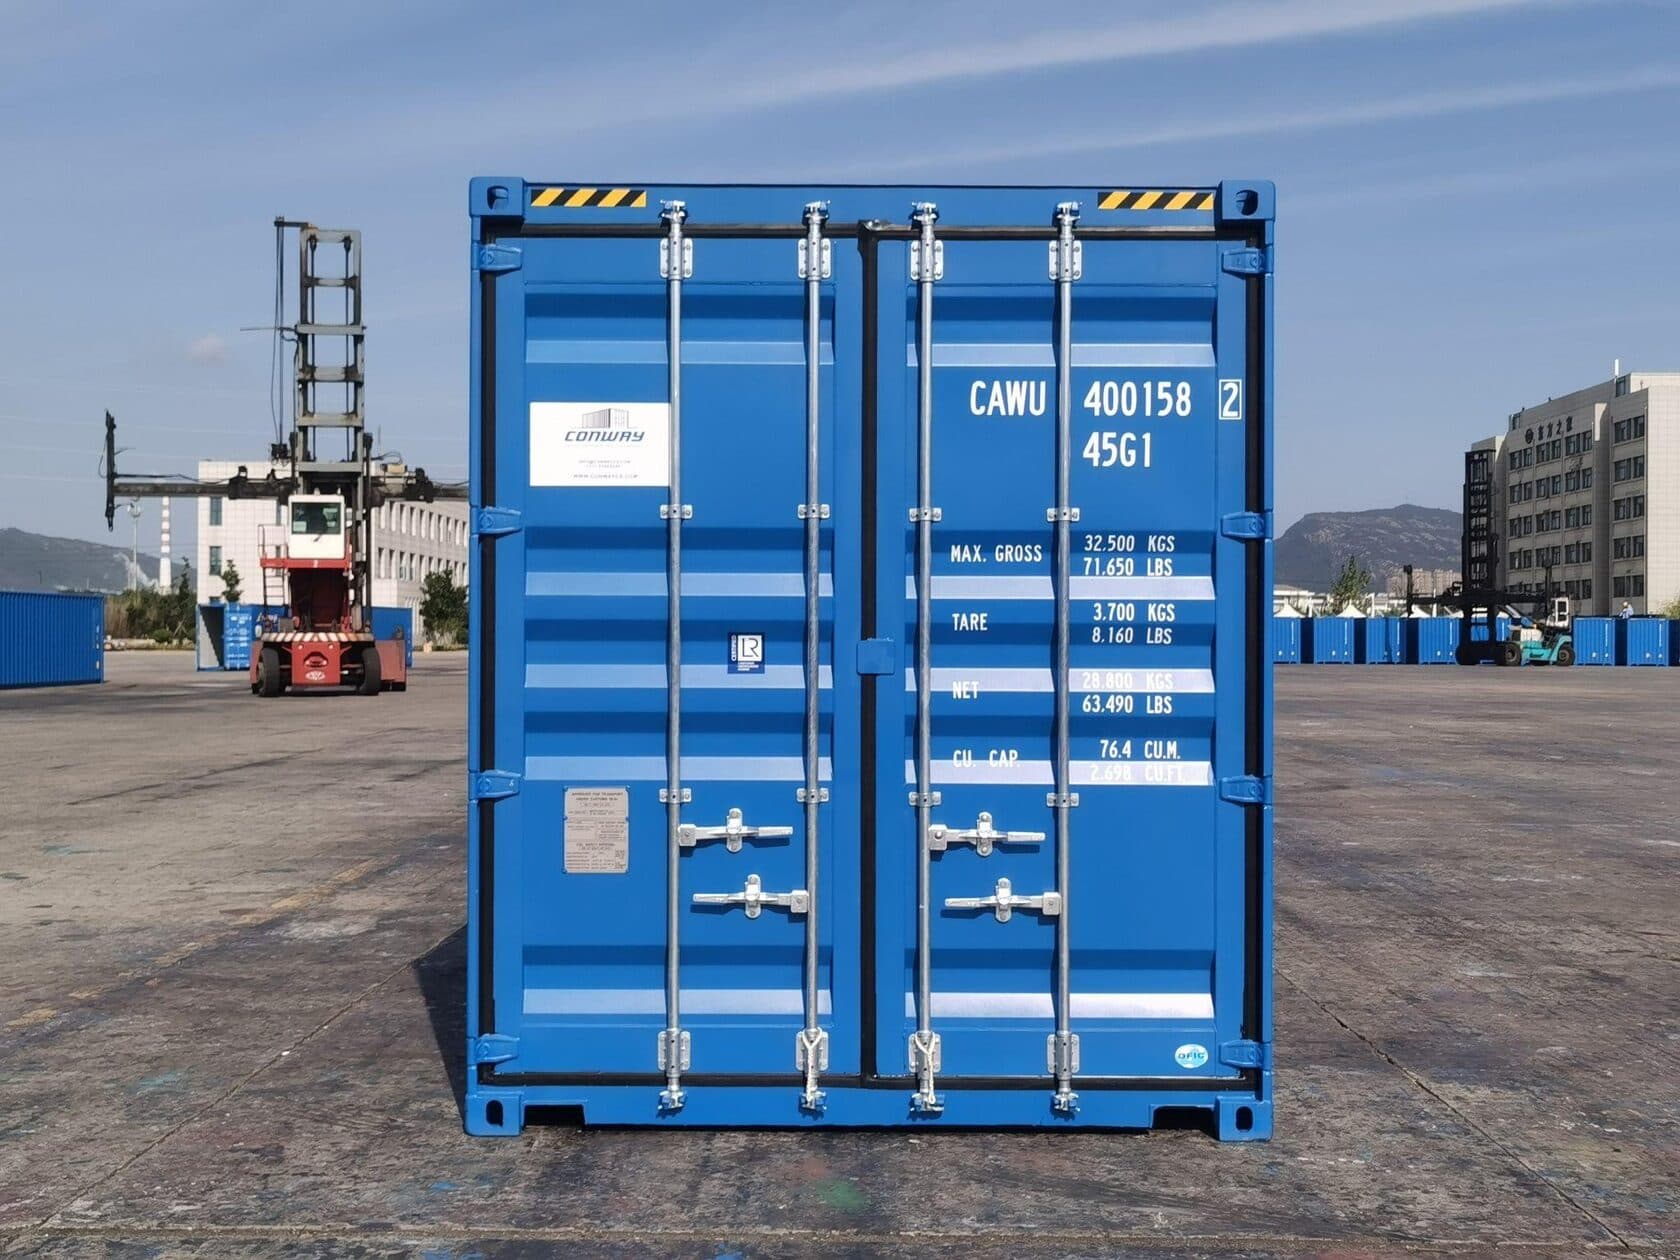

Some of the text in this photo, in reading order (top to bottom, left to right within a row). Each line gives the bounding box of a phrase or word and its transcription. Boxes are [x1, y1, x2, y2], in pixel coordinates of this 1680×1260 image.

[970, 380, 1239, 417] CAWU 400158 2
[564, 431, 645, 442] CONWAY
[1083, 431, 1151, 467] 45G1
[1148, 535, 1175, 552] KGS
[950, 544, 1042, 563] MAX. GROSS
[1146, 558, 1173, 576] LBS
[1148, 603, 1175, 622] KGS
[952, 613, 988, 631] TARE
[1146, 627, 1172, 644] LBS
[952, 681, 979, 699] NET
[1145, 672, 1173, 690] KGS
[1146, 695, 1172, 714] LBS
[1100, 740, 1181, 759] 76.4 CU.M.
[952, 750, 1020, 768] CU. CAP.
